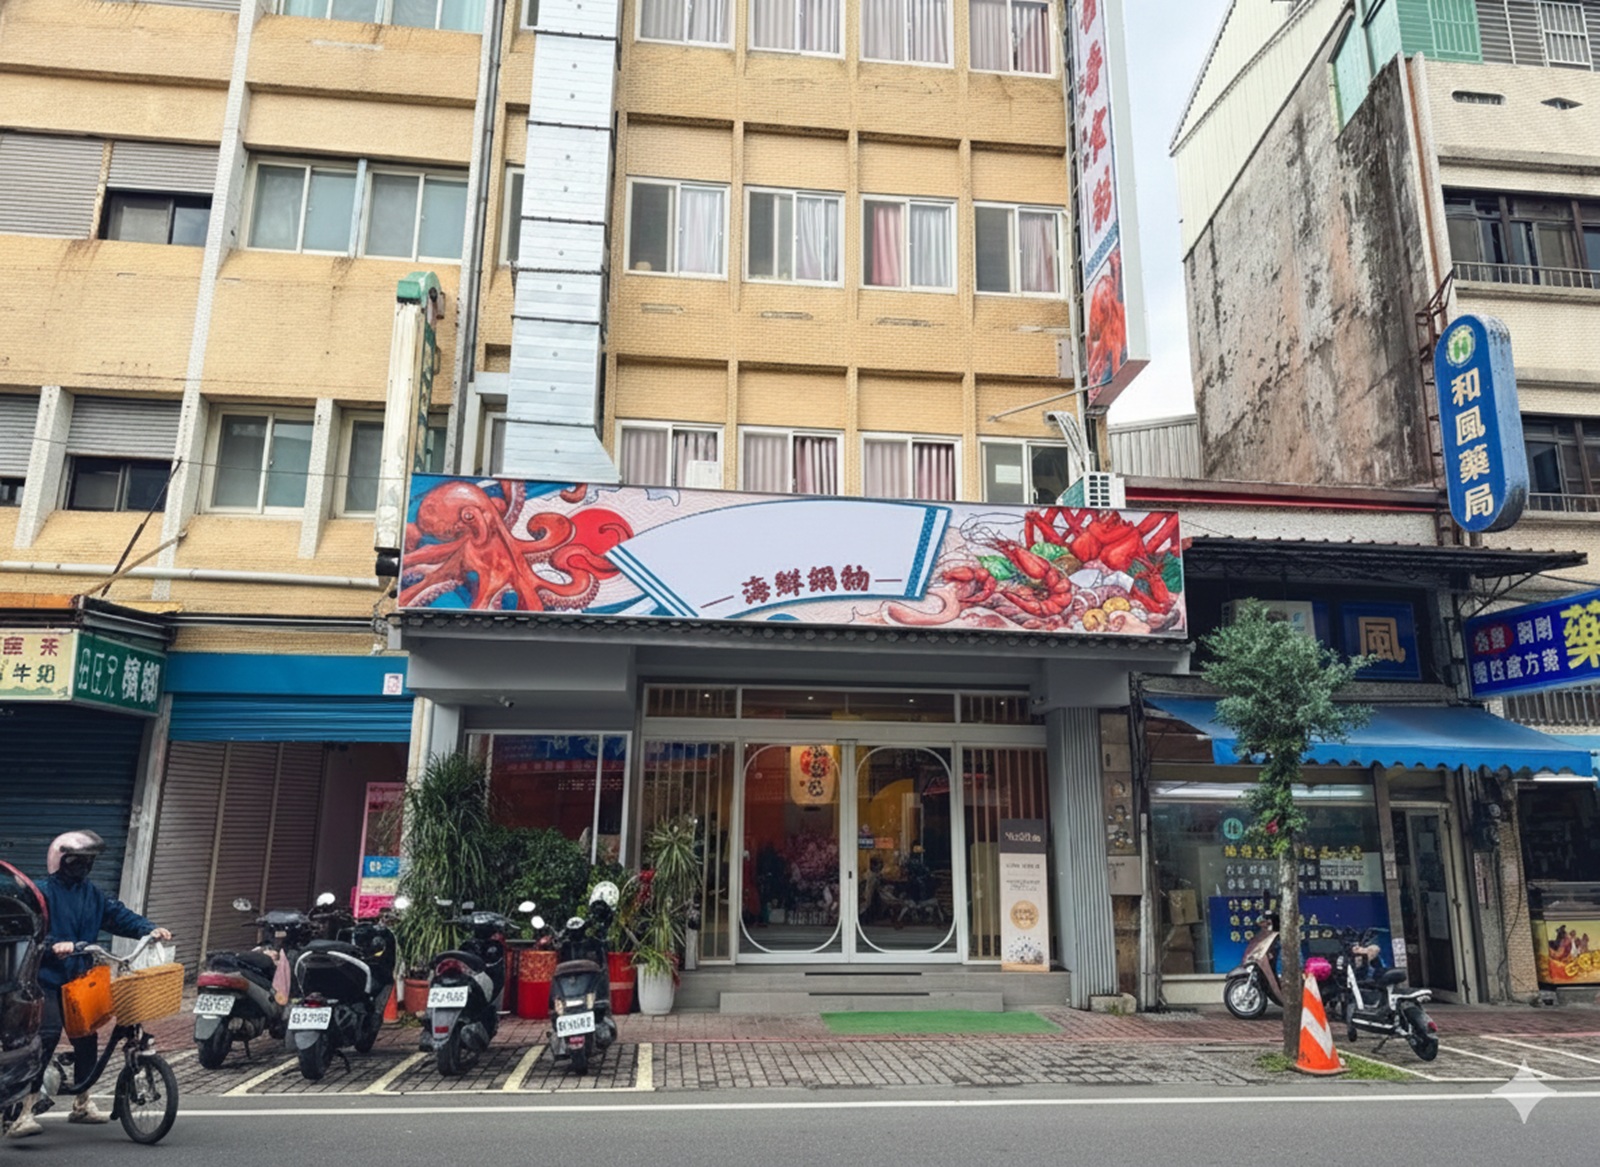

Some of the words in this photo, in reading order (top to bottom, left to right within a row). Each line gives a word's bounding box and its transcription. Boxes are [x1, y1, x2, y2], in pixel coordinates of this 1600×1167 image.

[1451, 367, 1494, 522] 和風藥局
[1358, 616, 1406, 663] 風
